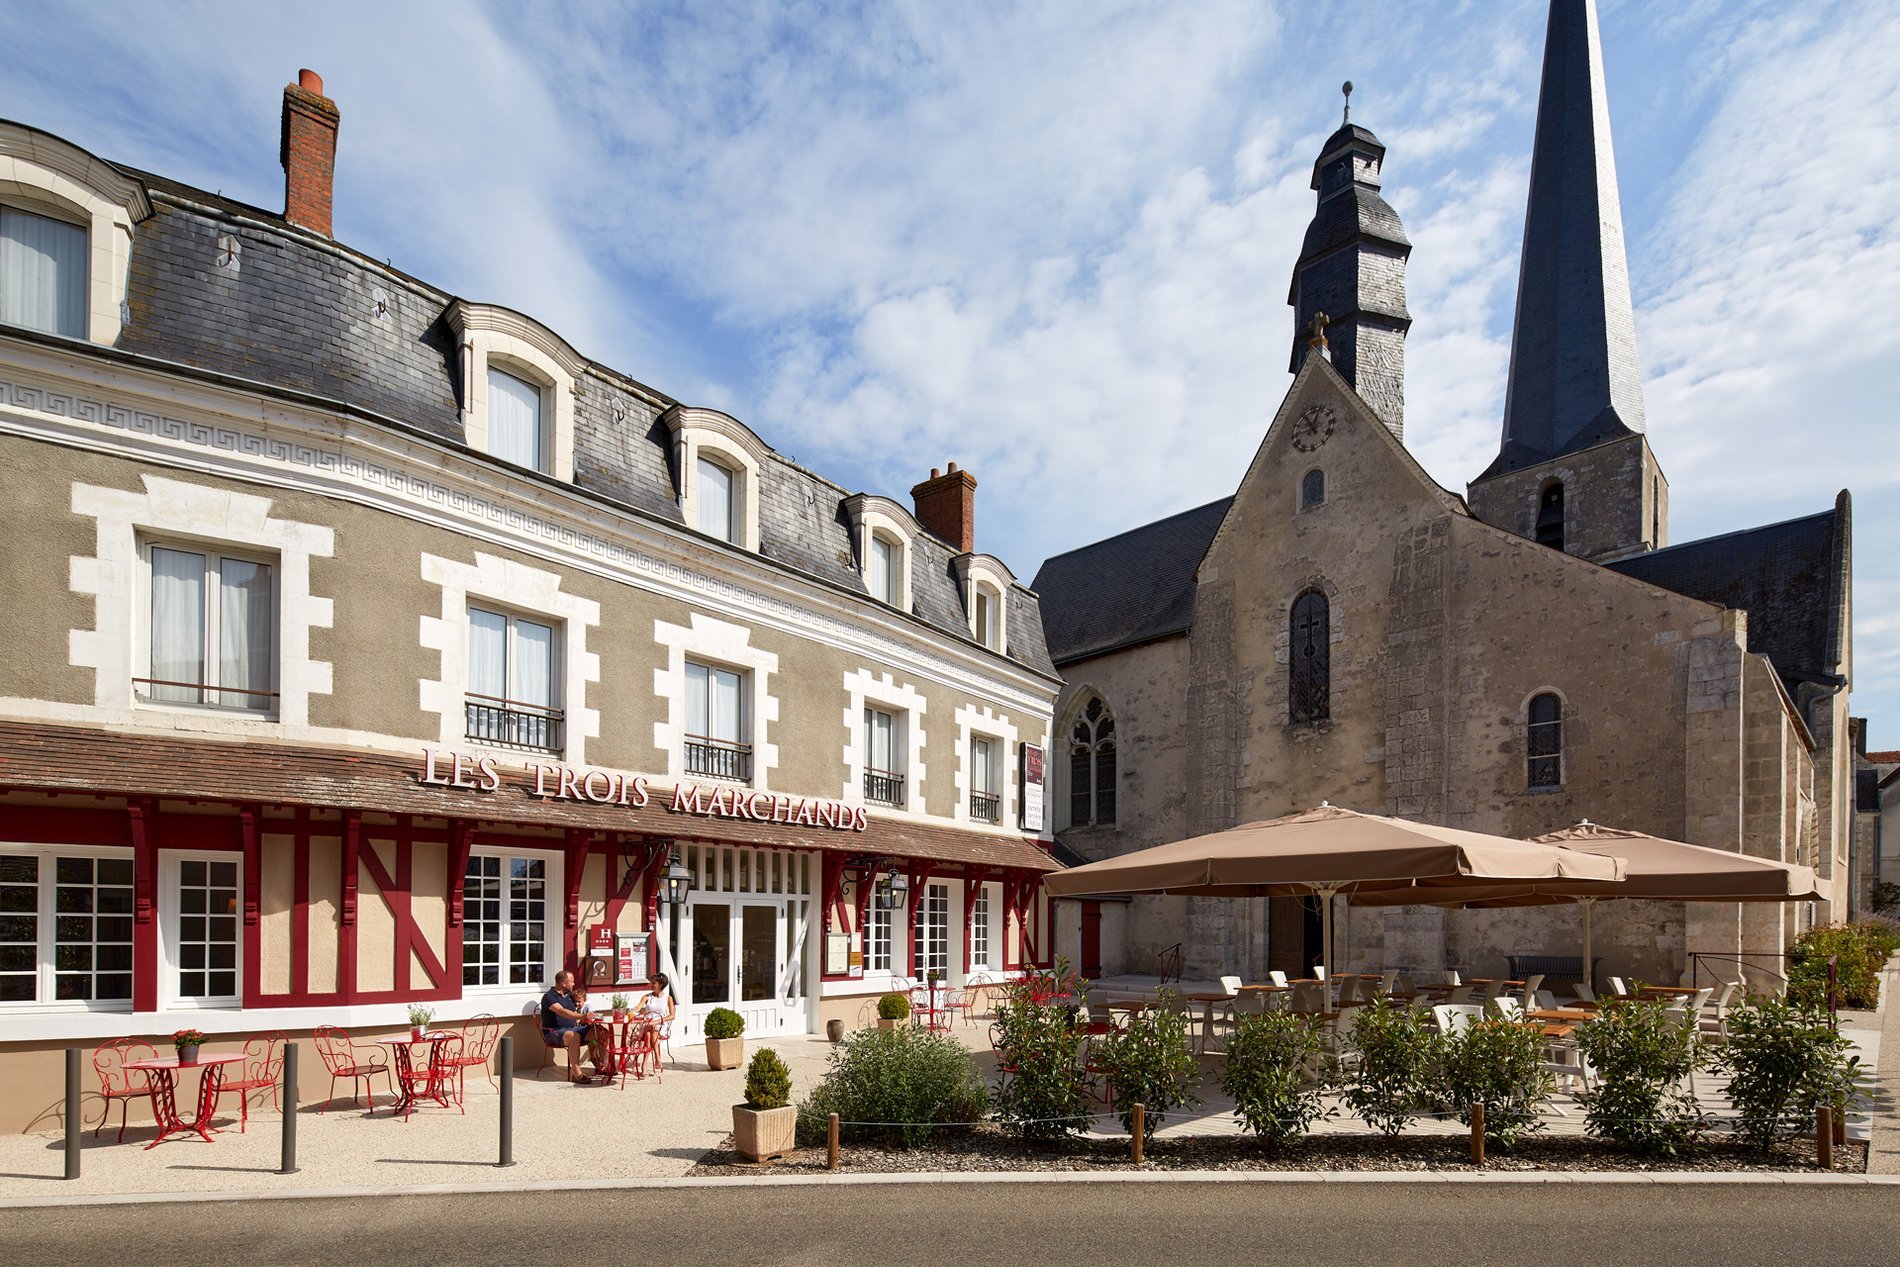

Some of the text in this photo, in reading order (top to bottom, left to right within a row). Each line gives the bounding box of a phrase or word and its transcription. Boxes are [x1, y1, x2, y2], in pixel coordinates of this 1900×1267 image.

[422, 748, 867, 831] LES TROIS MARCHANDS
[600, 928, 611, 939] H
